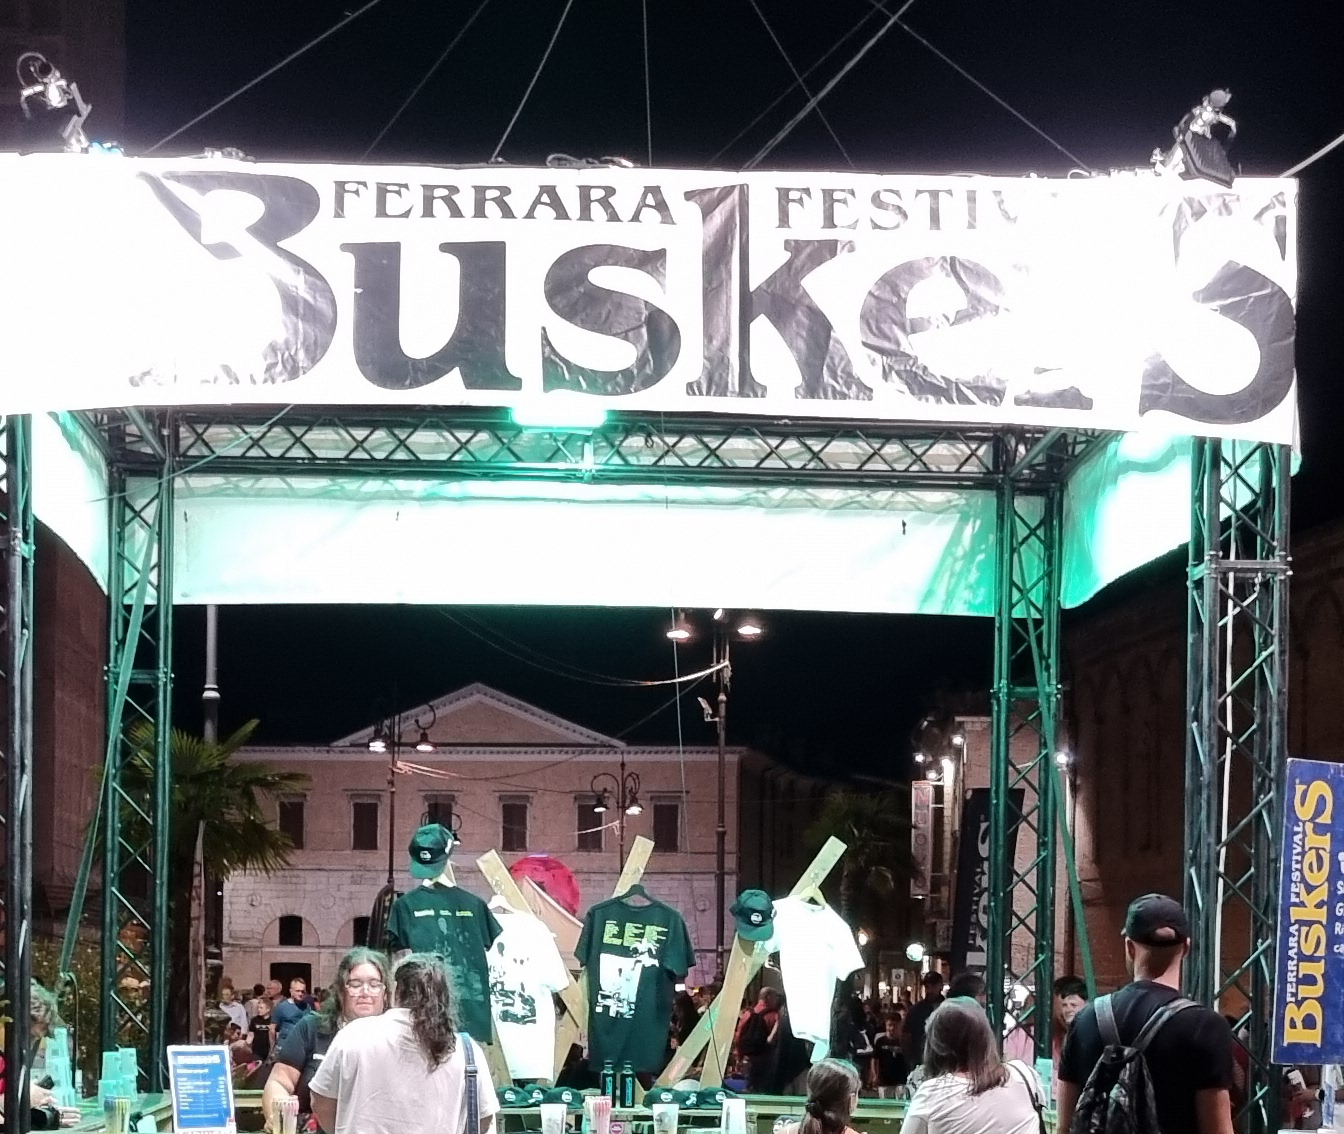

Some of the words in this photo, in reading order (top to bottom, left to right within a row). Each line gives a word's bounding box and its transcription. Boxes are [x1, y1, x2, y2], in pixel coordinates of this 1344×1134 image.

[332, 180, 677, 226] FERRARA
[1290, 821, 1304, 903] FESTIVAL
[1286, 924, 1299, 1003] FERRARA
